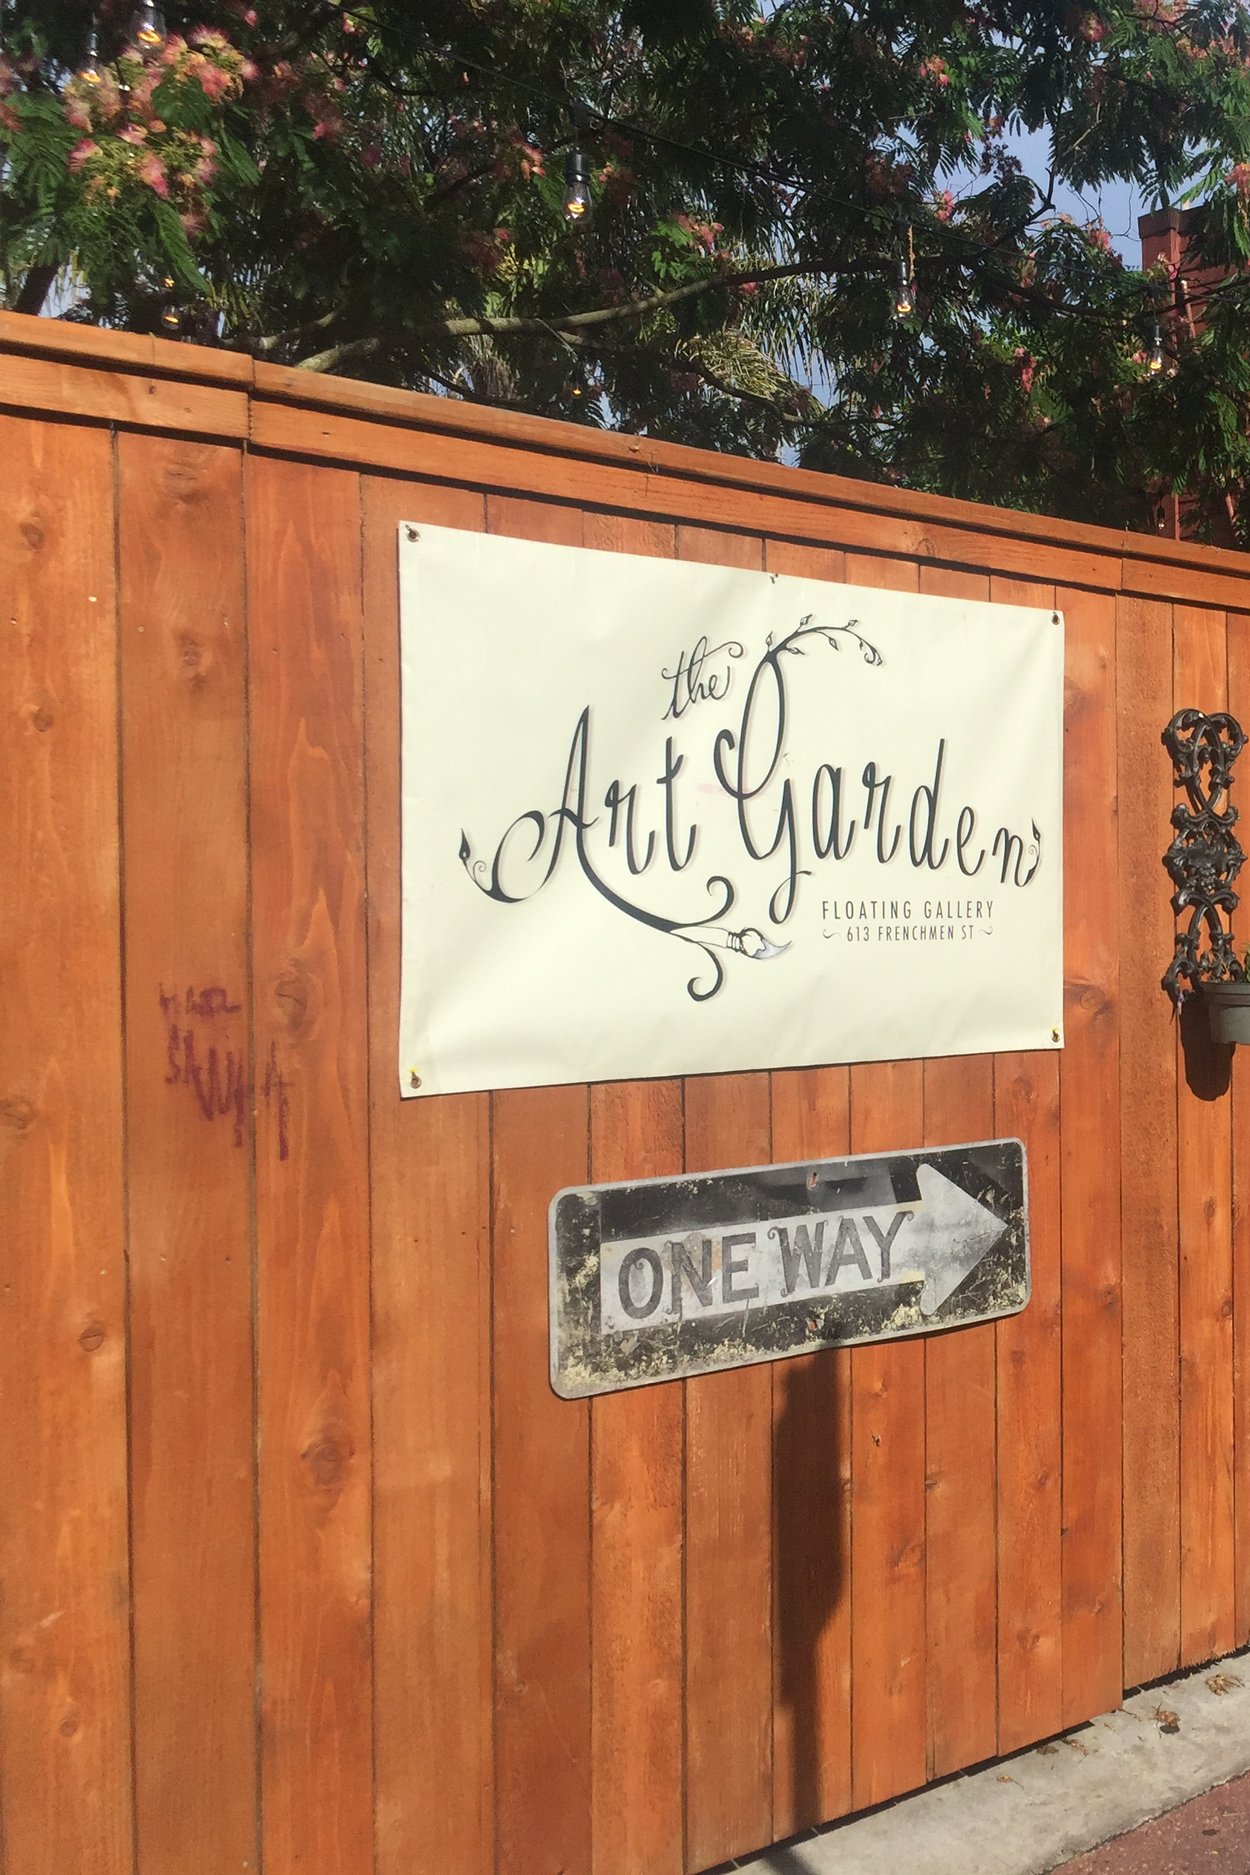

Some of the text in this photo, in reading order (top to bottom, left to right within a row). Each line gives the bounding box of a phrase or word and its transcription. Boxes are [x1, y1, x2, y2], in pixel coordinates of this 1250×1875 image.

[661, 635, 743, 721] the
[462, 650, 1040, 925] Art Garden
[821, 900, 994, 920] FLOATING GALLERY
[846, 925, 974, 942] 613 FRENCHMEN ST
[618, 1210, 915, 1320] ONE WAY
